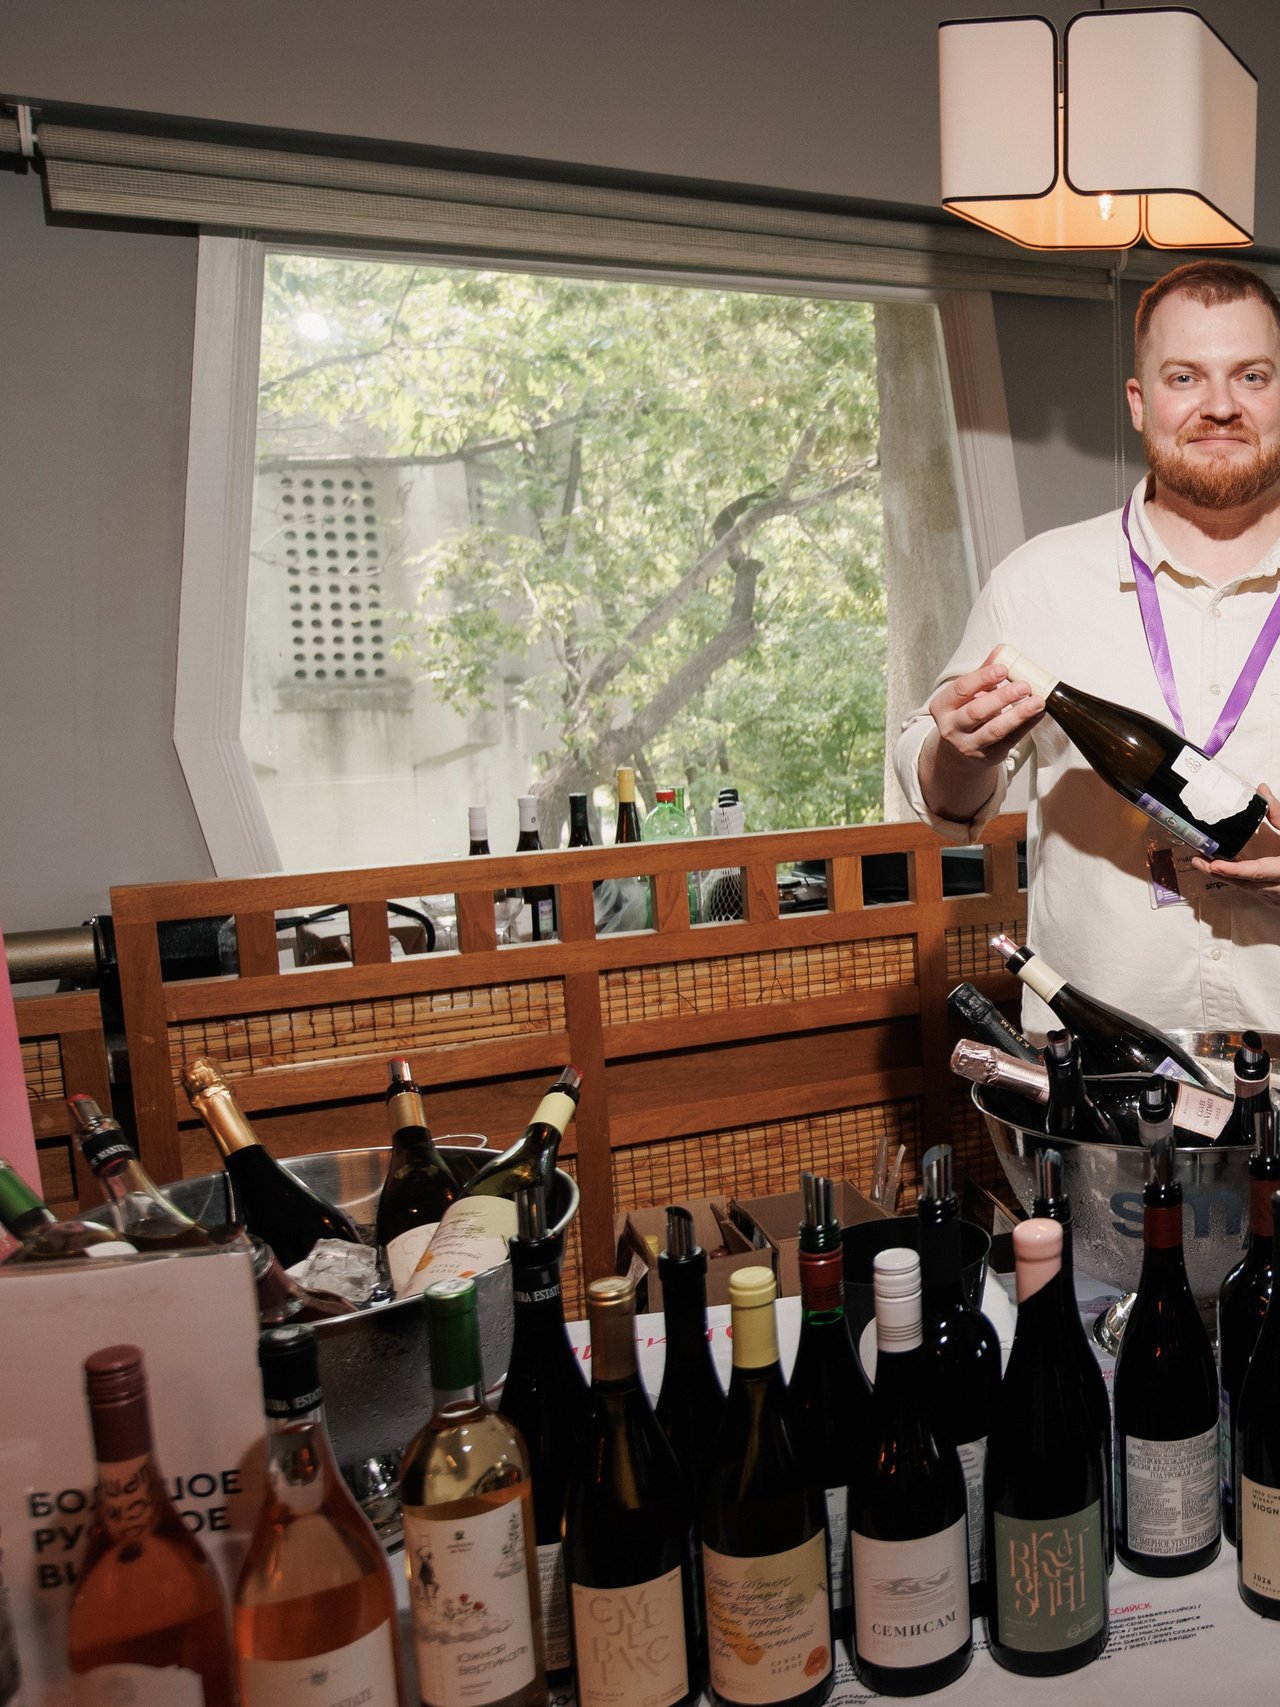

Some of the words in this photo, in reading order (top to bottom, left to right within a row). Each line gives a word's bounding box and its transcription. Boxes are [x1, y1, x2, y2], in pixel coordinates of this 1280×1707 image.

[1000, 1019, 1030, 1049] КРЫМ
[533, 1283, 561, 1302] ESTATE
[28, 1469, 244, 1518] БООЕ
[1253, 1572, 1272, 1585] 2024
[872, 1609, 956, 1637] СЕМИСАМ
